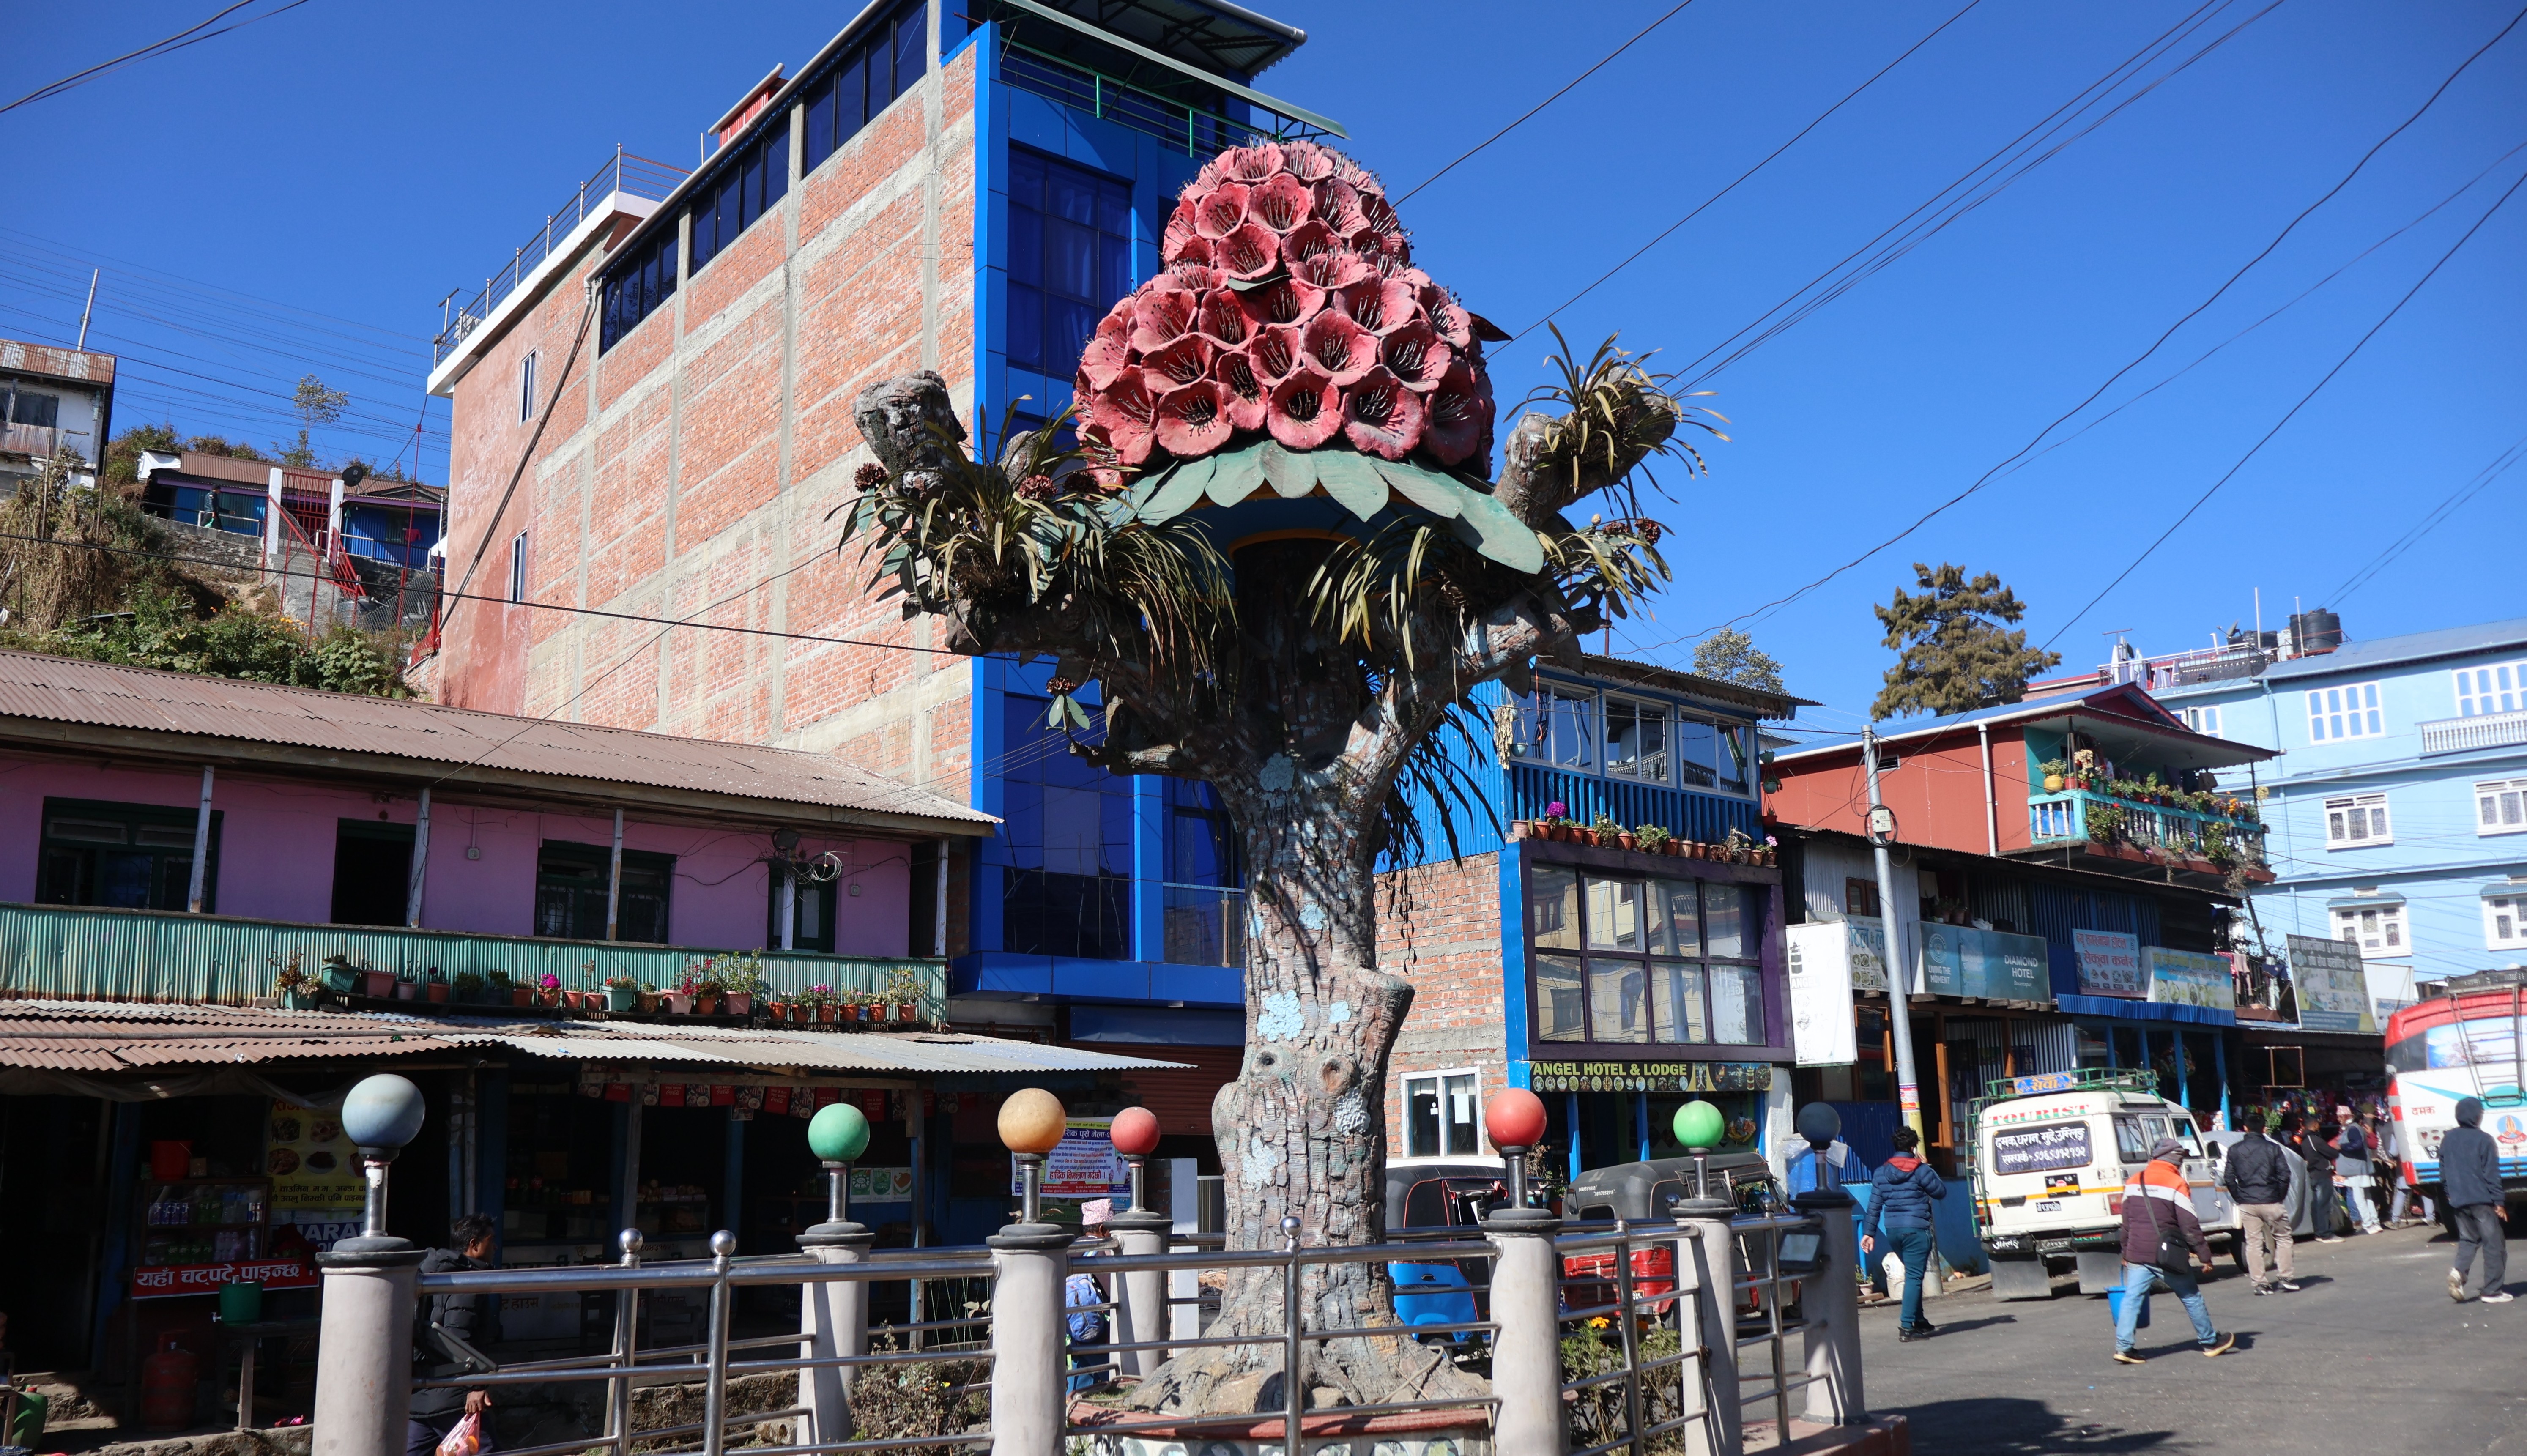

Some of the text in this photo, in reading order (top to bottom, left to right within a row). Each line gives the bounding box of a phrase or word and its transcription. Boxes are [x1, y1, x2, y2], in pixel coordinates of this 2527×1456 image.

[2004, 955, 2038, 967] DIAMOND
[1928, 965, 1951, 975] LIVING THE
[2012, 967, 2034, 979] HOTEL
[1930, 975, 1950, 984] MOMENT
[1533, 1063, 1687, 1076] ANGEL HOTEL & LODGE
[2031, 1076, 2058, 1091] सेवा
[1989, 1105, 2089, 1125] TOURIST
[2412, 1106, 2435, 1115] दमक
[1064, 1128, 1078, 1137] सिक
[1079, 1129, 1090, 1139] पुसे
[1050, 1170, 1065, 1180] हार्दिक
[137, 1267, 175, 1287] यहाँ
[241, 1263, 301, 1281] पाइन्छ
[511, 1297, 539, 1311] हाउस
